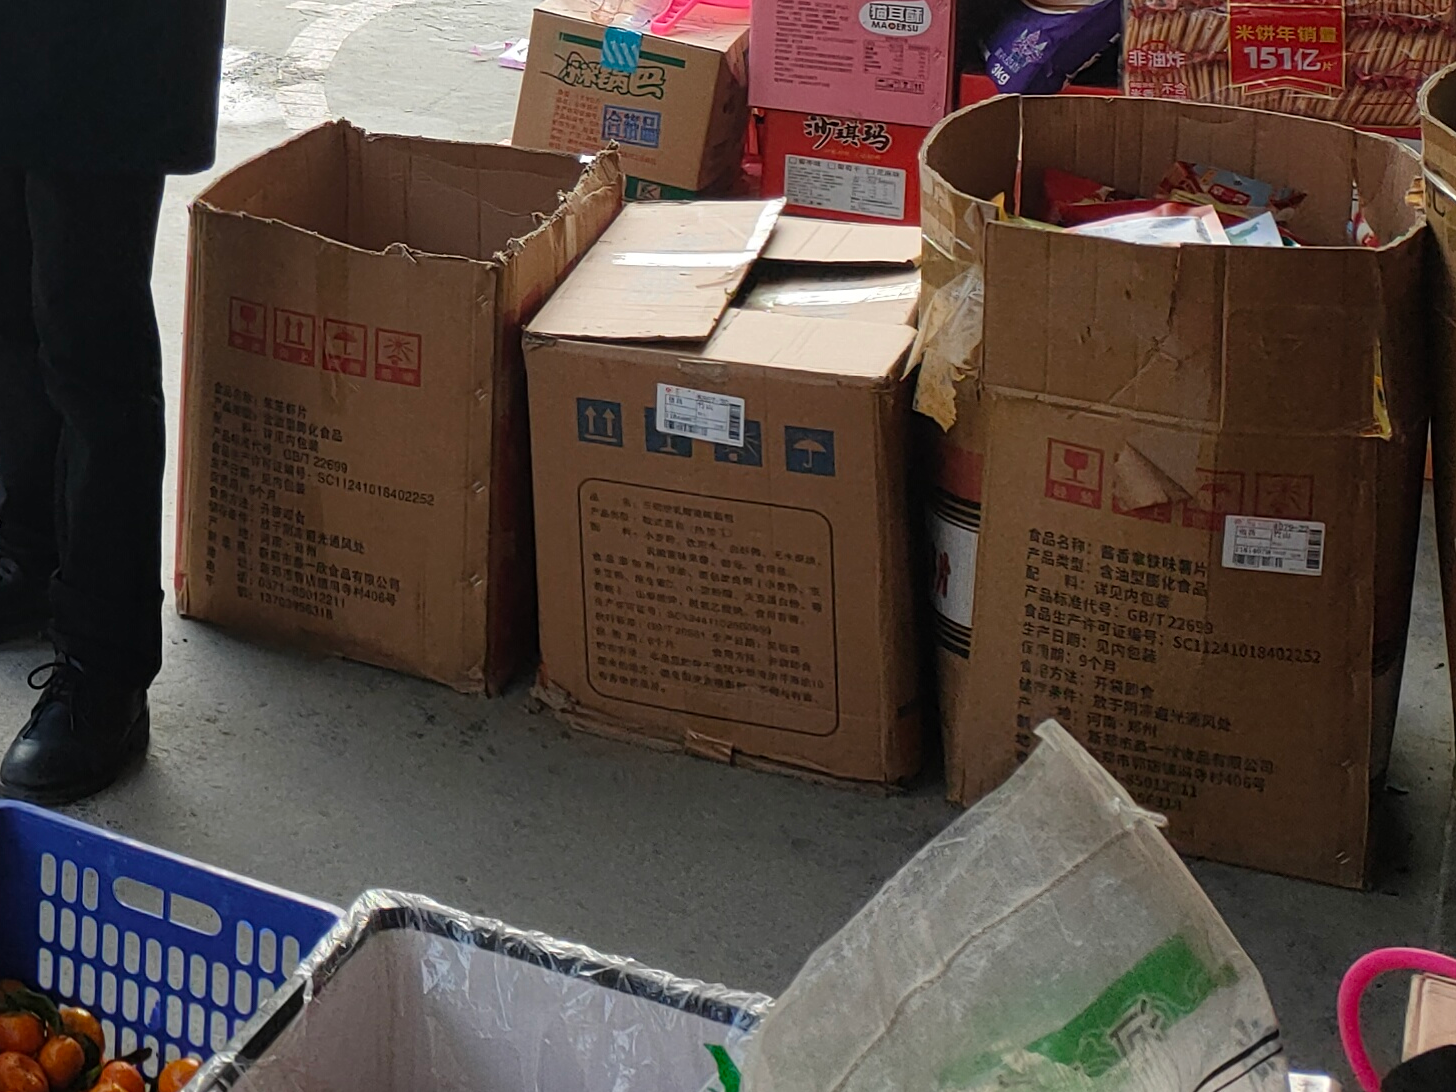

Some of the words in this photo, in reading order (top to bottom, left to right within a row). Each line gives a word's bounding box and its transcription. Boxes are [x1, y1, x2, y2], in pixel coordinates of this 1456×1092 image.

[1235, 24, 1338, 43] 米饼年销量
[1128, 50, 1187, 69] 非油炸
[991, 62, 1011, 86] 3kg
[803, 115, 892, 153] 沙琪玛
